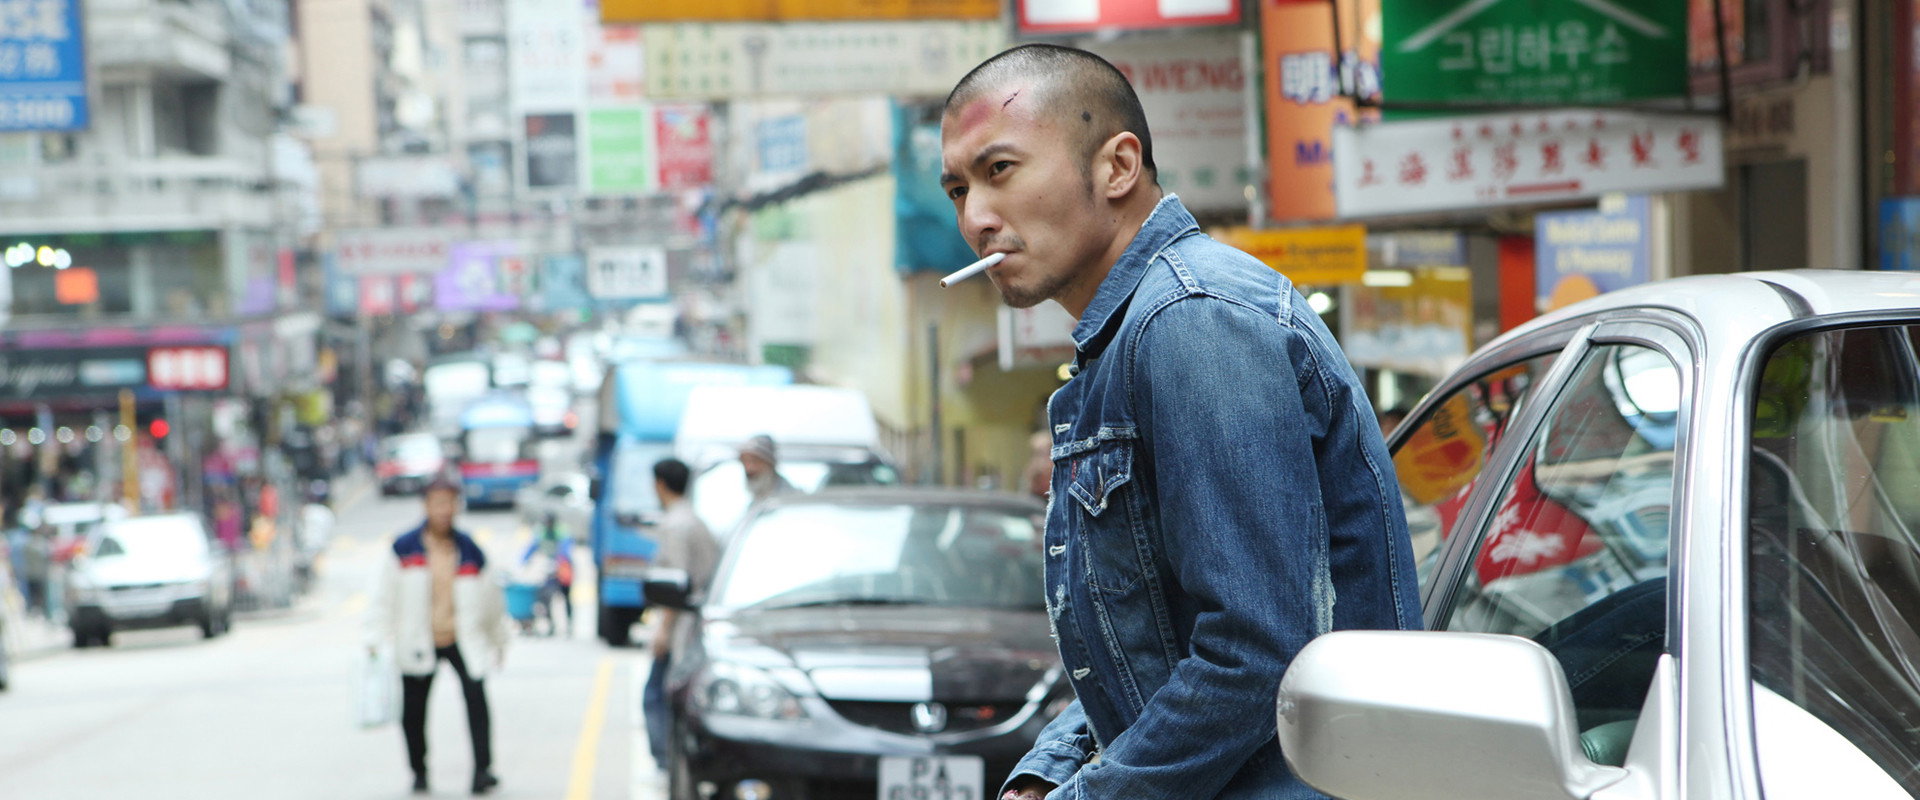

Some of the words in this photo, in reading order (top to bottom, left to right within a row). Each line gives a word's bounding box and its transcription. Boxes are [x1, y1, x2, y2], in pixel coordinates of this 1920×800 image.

[1438, 20, 1634, 74] 그린하우스
[1142, 56, 1246, 94] WENG
[910, 757, 952, 791] PA
